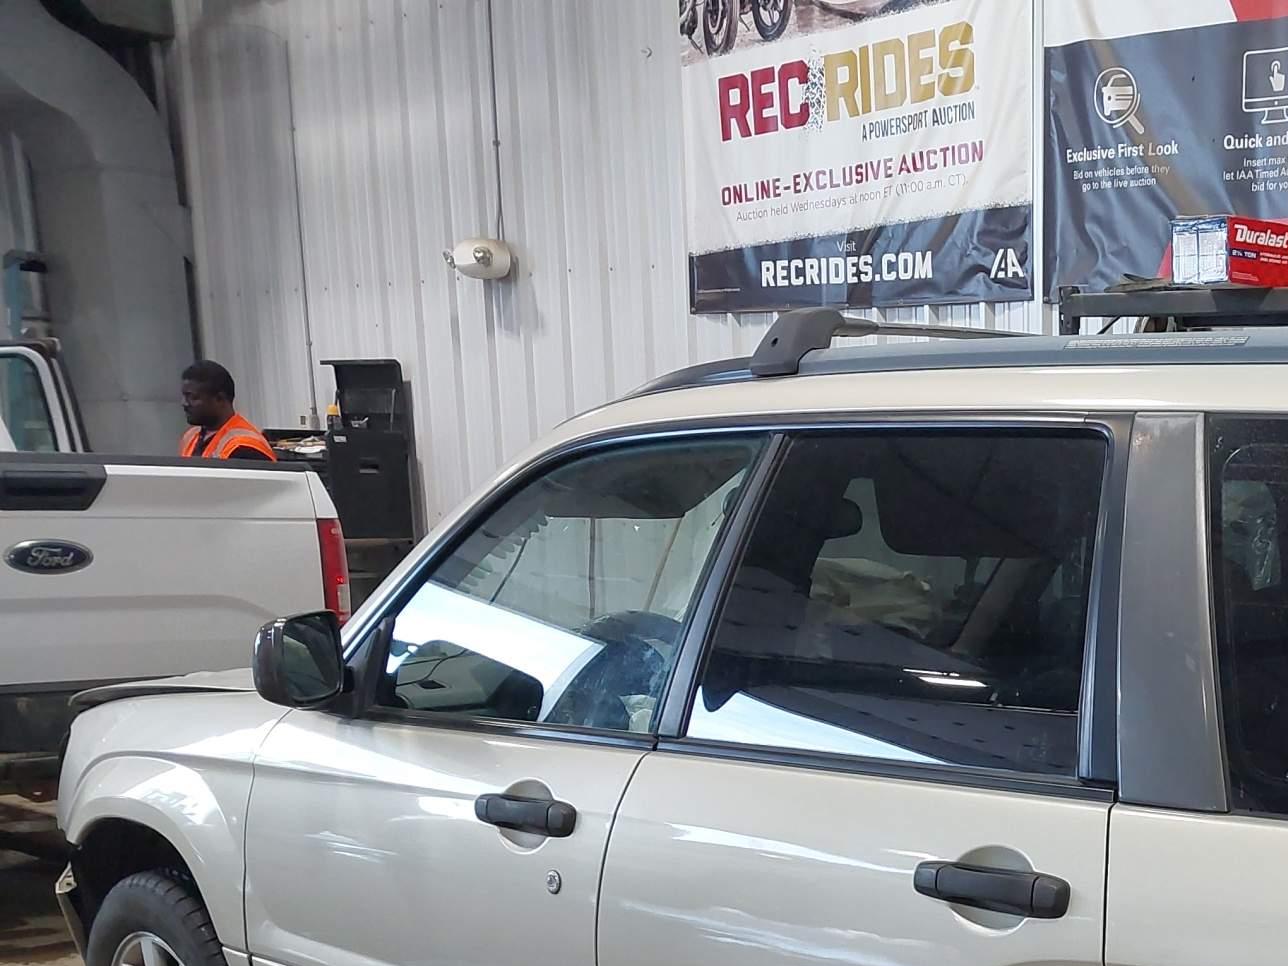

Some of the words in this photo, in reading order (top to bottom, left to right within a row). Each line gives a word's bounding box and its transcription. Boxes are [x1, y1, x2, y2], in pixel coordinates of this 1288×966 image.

[718, 60, 809, 142] REC
[823, 21, 975, 122] RIDES
[862, 124, 868, 142] A
[869, 110, 928, 140] POWERSPORT
[932, 101, 976, 126] AUCTION
[1223, 133, 1263, 149] Quick
[1066, 146, 1116, 163] Exclusive
[1118, 143, 1144, 158] First
[1148, 139, 1179, 156] Look
[1243, 157, 1266, 167] Insert
[1268, 156, 1286, 166] max
[721, 157, 894, 206] ONLINE-EXCLUSIVE
[898, 140, 984, 175] AUCTION
[1073, 170, 1083, 180] Bid
[1084, 171, 1093, 179] on
[1094, 167, 1125, 177] vehicles
[1126, 165, 1149, 175] before
[1151, 164, 1170, 175] they
[1223, 170, 1234, 180] let
[1236, 170, 1254, 180] IAA
[1255, 167, 1279, 179] Timed
[1082, 182, 1091, 192] go
[1100, 180, 1112, 189] the
[1114, 178, 1128, 188] live
[1130, 177, 1156, 187] auction
[1251, 181, 1264, 192] bid
[1266, 180, 1277, 191] for
[736, 208, 768, 222] Auction
[770, 204, 788, 217] held
[792, 194, 847, 213] Wednesdays
[850, 193, 857, 205] at
[859, 190, 881, 202] noon
[884, 185, 892, 198] ET
[836, 240, 857, 252] Visit
[761, 251, 933, 287] RECRIDES.COM
[26, 546, 75, 568] Ford
